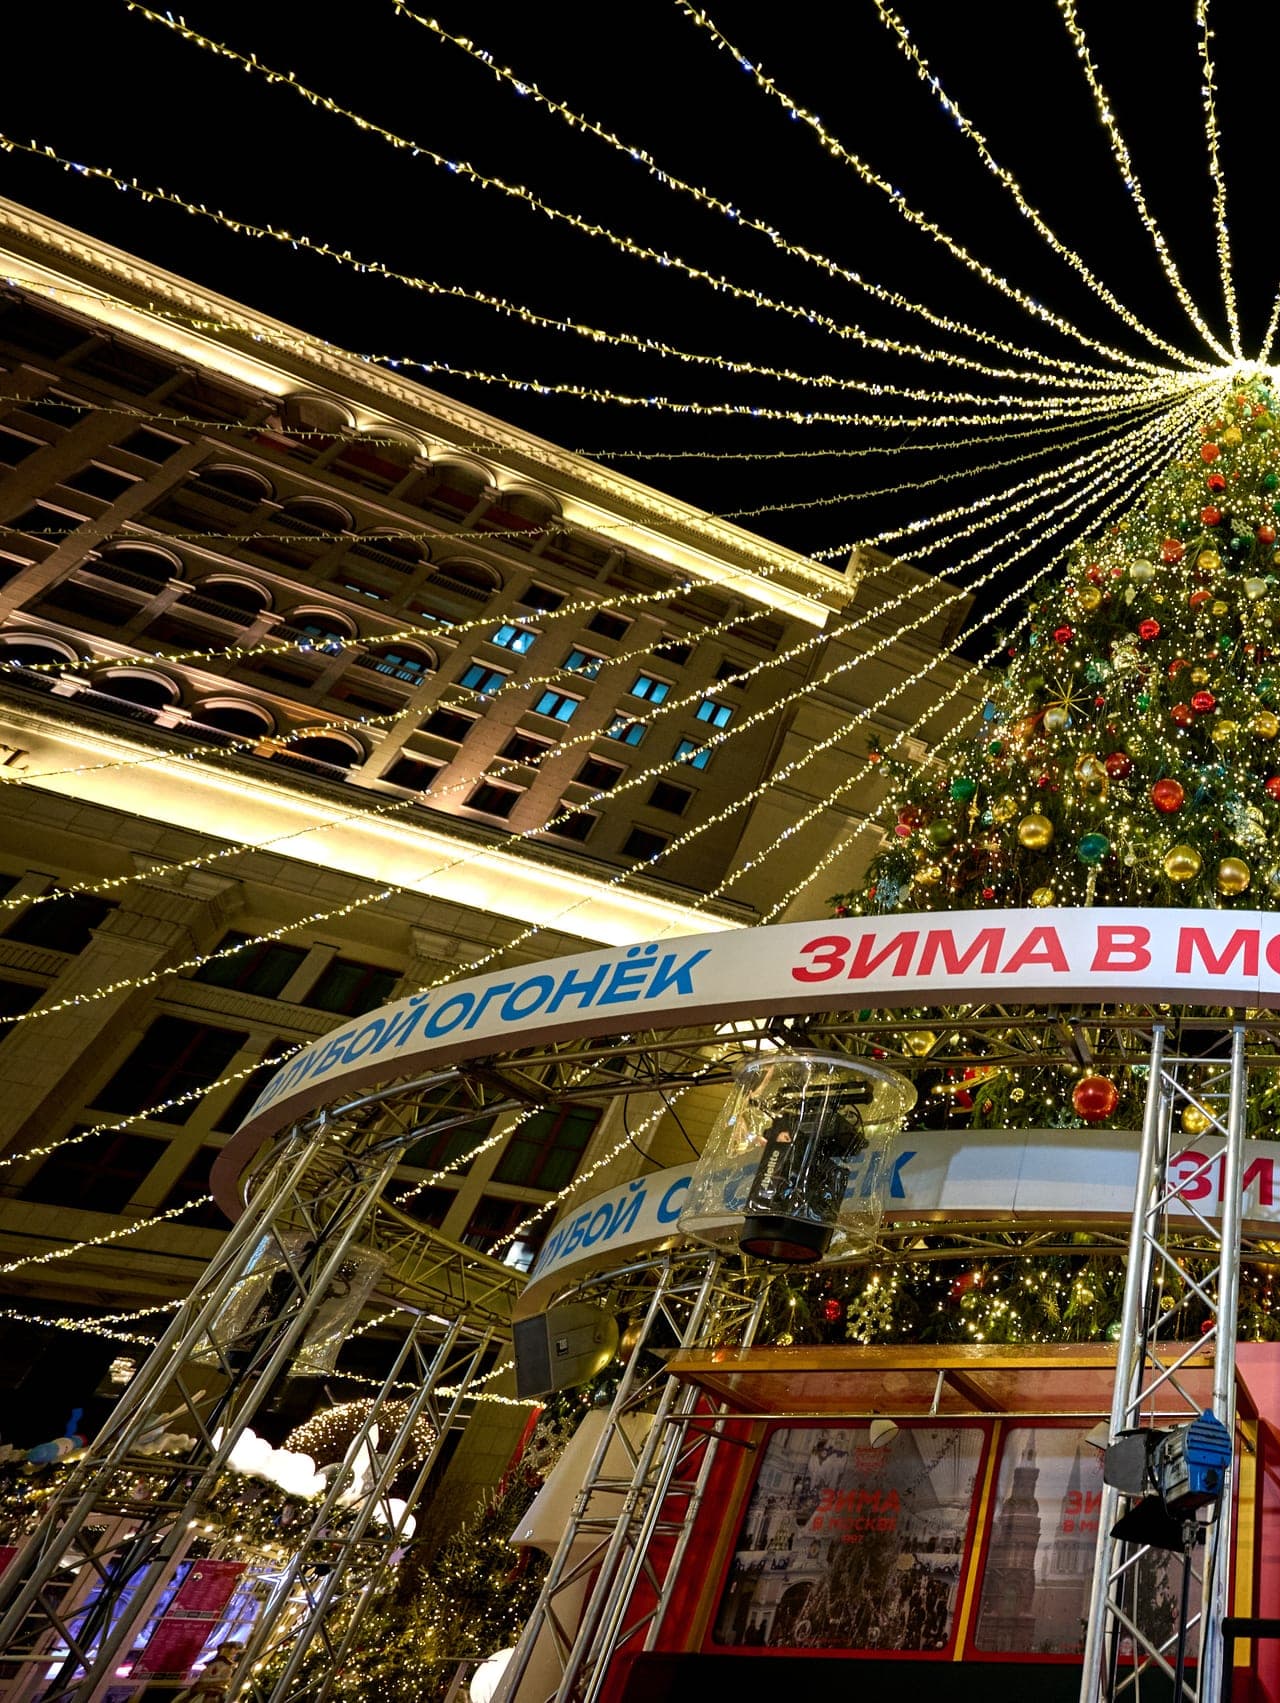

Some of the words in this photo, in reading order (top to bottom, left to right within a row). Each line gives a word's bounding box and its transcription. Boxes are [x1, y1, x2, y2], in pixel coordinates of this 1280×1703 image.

[791, 925, 1070, 983] ЗИМА
[1090, 924, 1153, 972] В
[423, 943, 713, 1039] ОГОНЁК
[816, 1487, 901, 1514] ЗИМА
